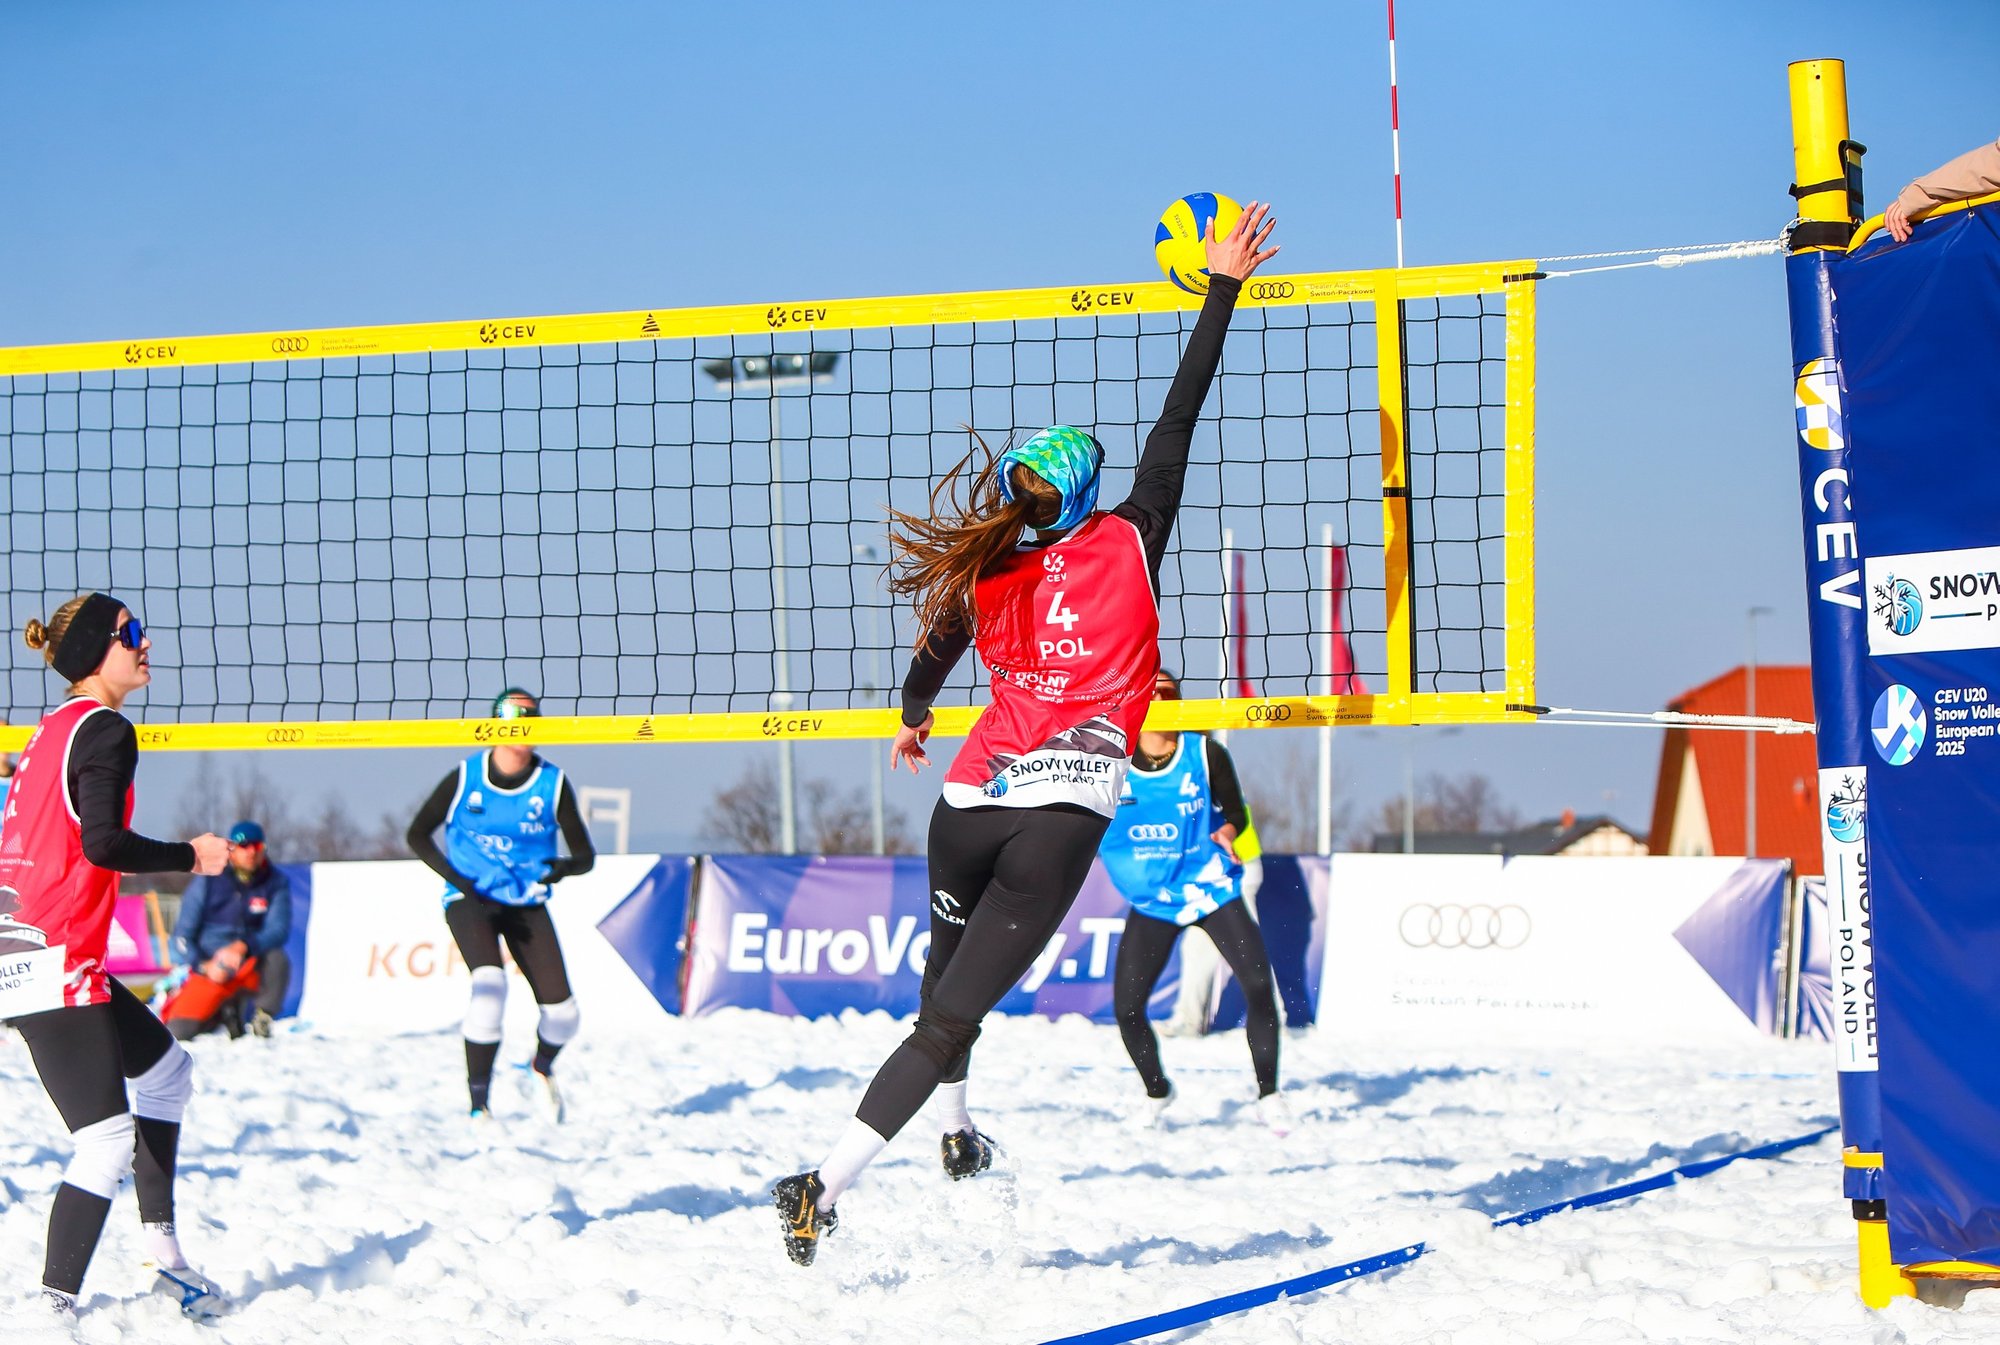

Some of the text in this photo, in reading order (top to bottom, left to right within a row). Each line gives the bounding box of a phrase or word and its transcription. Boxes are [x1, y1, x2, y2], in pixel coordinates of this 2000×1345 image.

[1097, 292, 1134, 307] CEV
[791, 308, 827, 322] CEV
[502, 325, 536, 339] CEV
[146, 346, 177, 359] CEV
[1813, 467, 1863, 611] CEV
[1046, 572, 1067, 583] CEV
[1046, 591, 1079, 632] 4
[1039, 637, 1093, 660] POL
[1934, 687, 1988, 704] CEV U20
[1934, 706, 1969, 721] Snow
[497, 726, 532, 738] CEV
[787, 719, 823, 732] CEV
[1935, 723, 1995, 741] European
[141, 731, 172, 743] CEV
[1935, 740, 1966, 756] 2025
[1010, 758, 1112, 778] SNOW VOLLEY
[1179, 772, 1200, 798] 4
[526, 795, 545, 821] 3
[1177, 797, 1206, 816] TUR
[932, 902, 966, 925] ORLEN
[0, 961, 32, 979] LLEY
[1840, 928, 1858, 1034] POLAND
